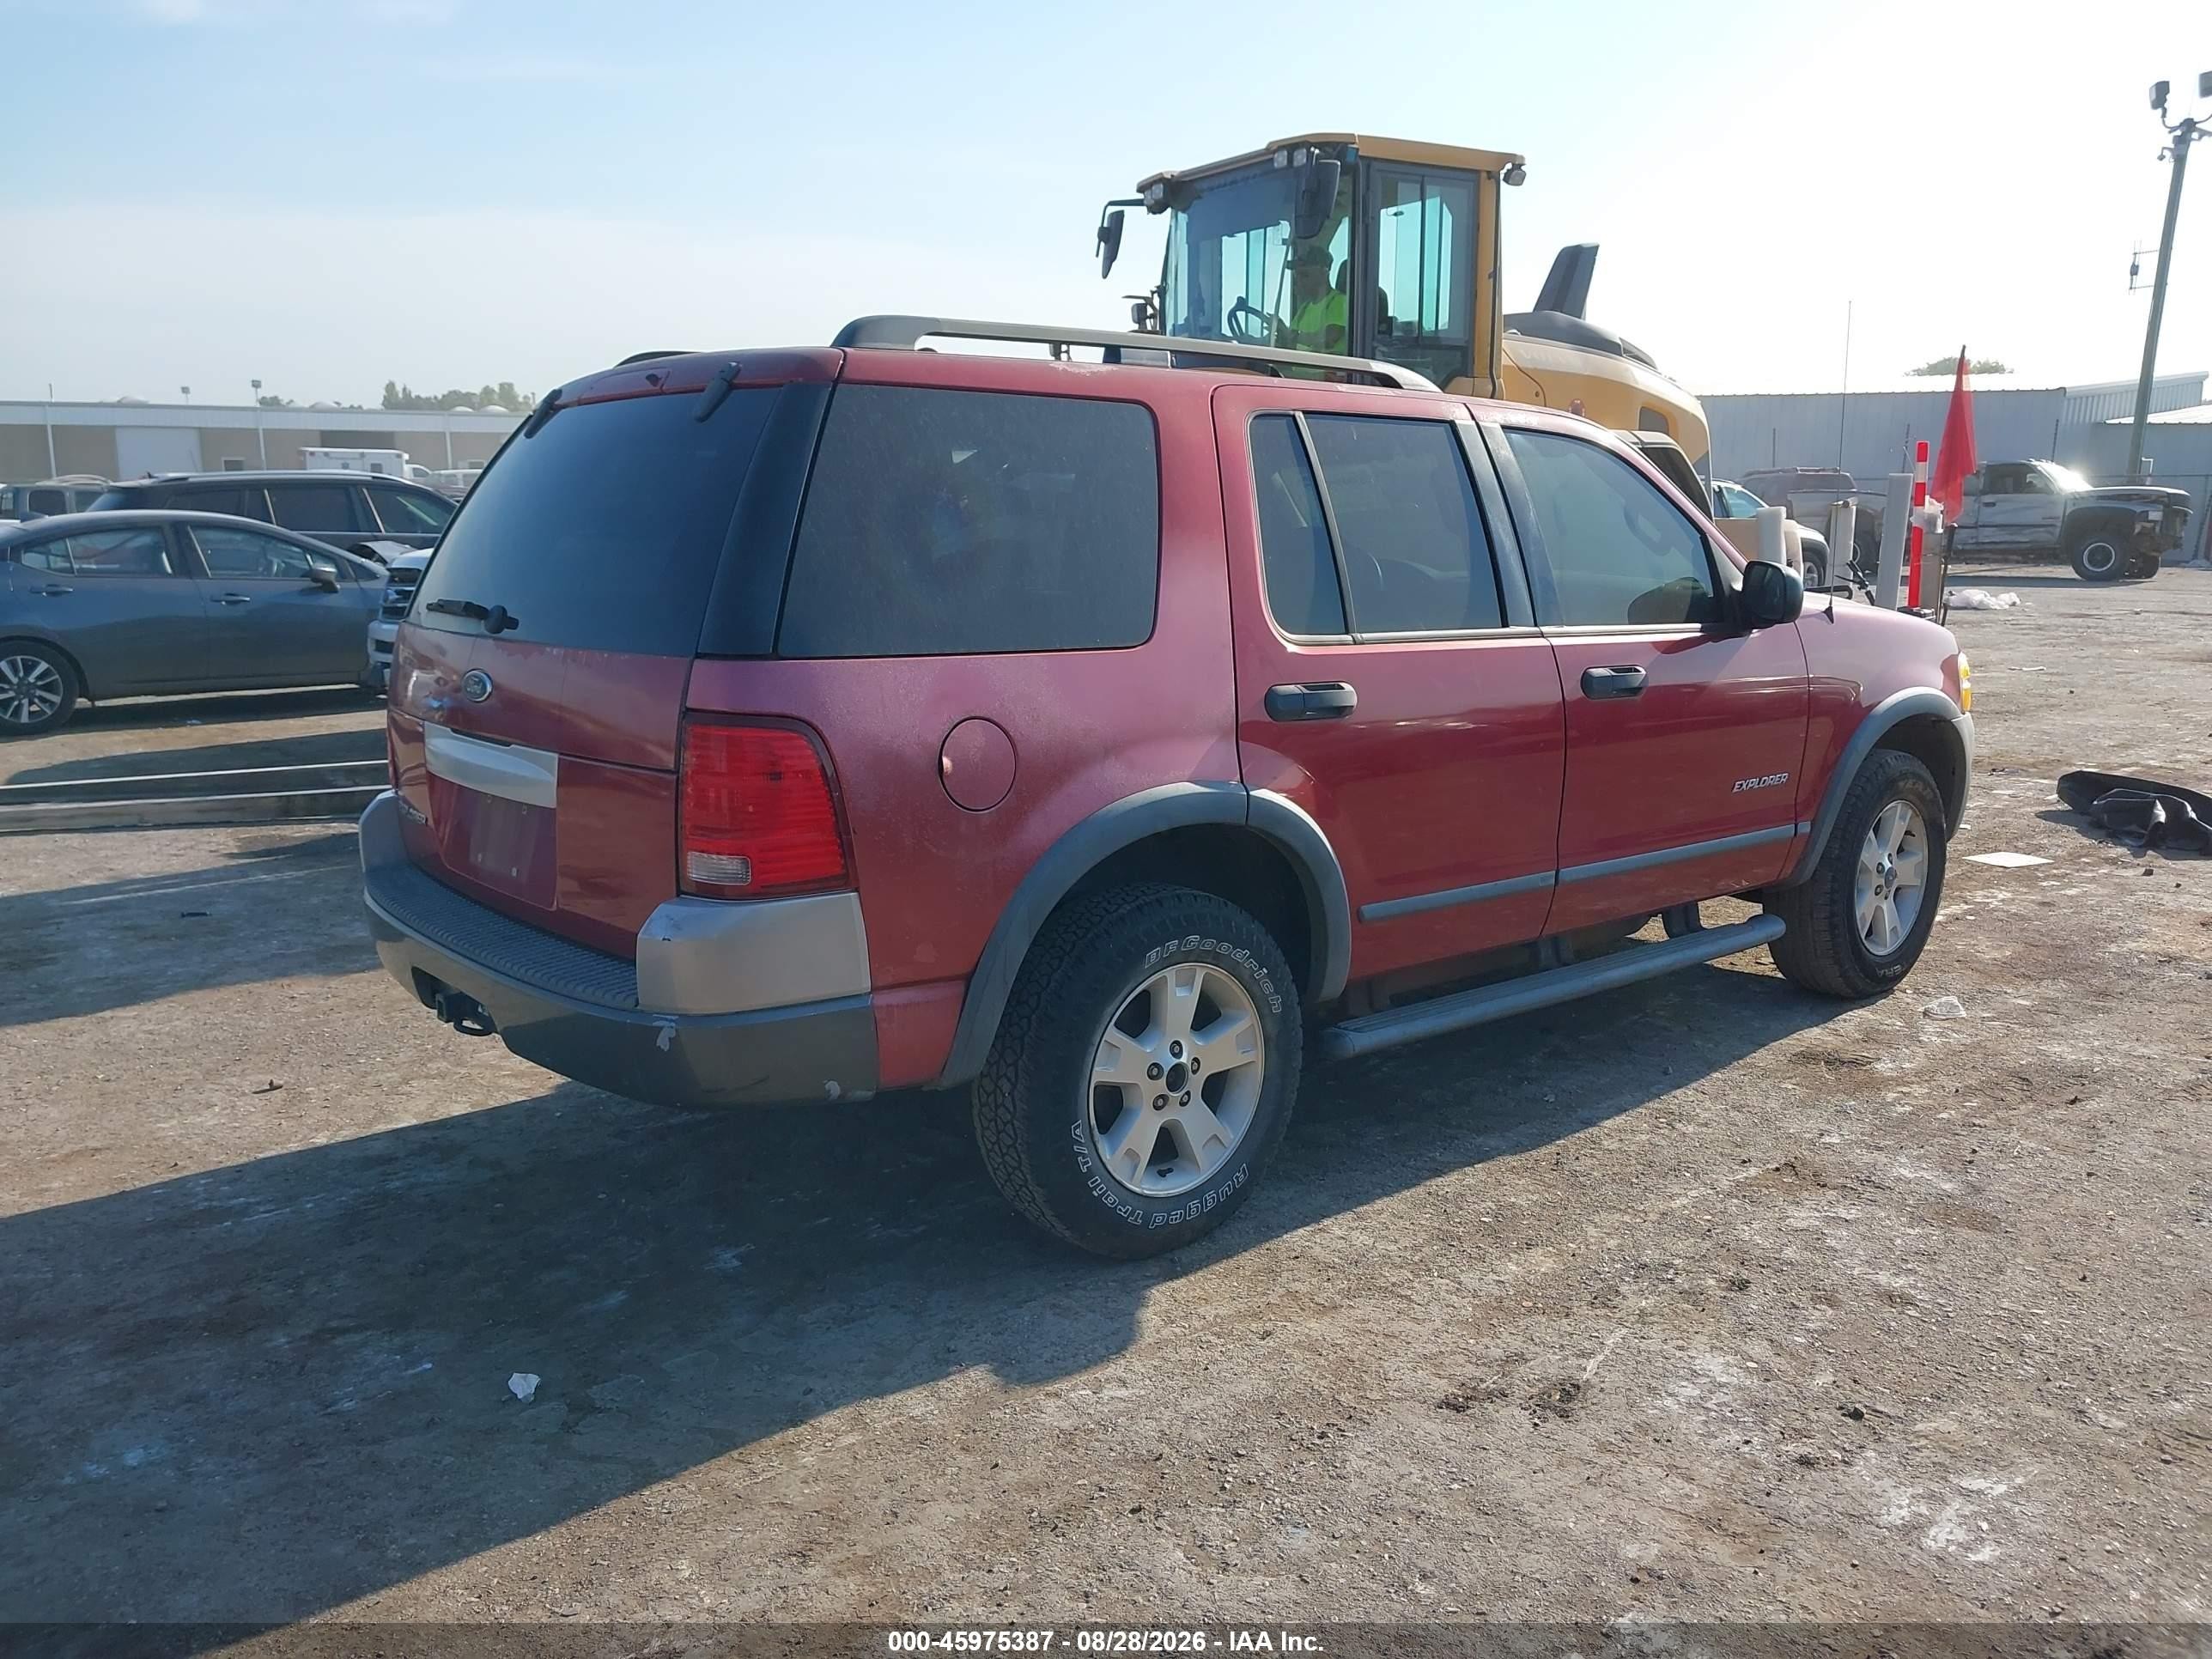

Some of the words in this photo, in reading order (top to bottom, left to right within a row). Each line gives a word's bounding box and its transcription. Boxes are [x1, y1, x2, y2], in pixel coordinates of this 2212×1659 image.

[1732, 772, 1789, 793] EXPLORER
[1144, 935, 1282, 1013] BFGoodrich
[1071, 1119, 1092, 1173] T/A
[1087, 1176, 1144, 1224] Trail
[1148, 1163, 1249, 1229] Rugged
